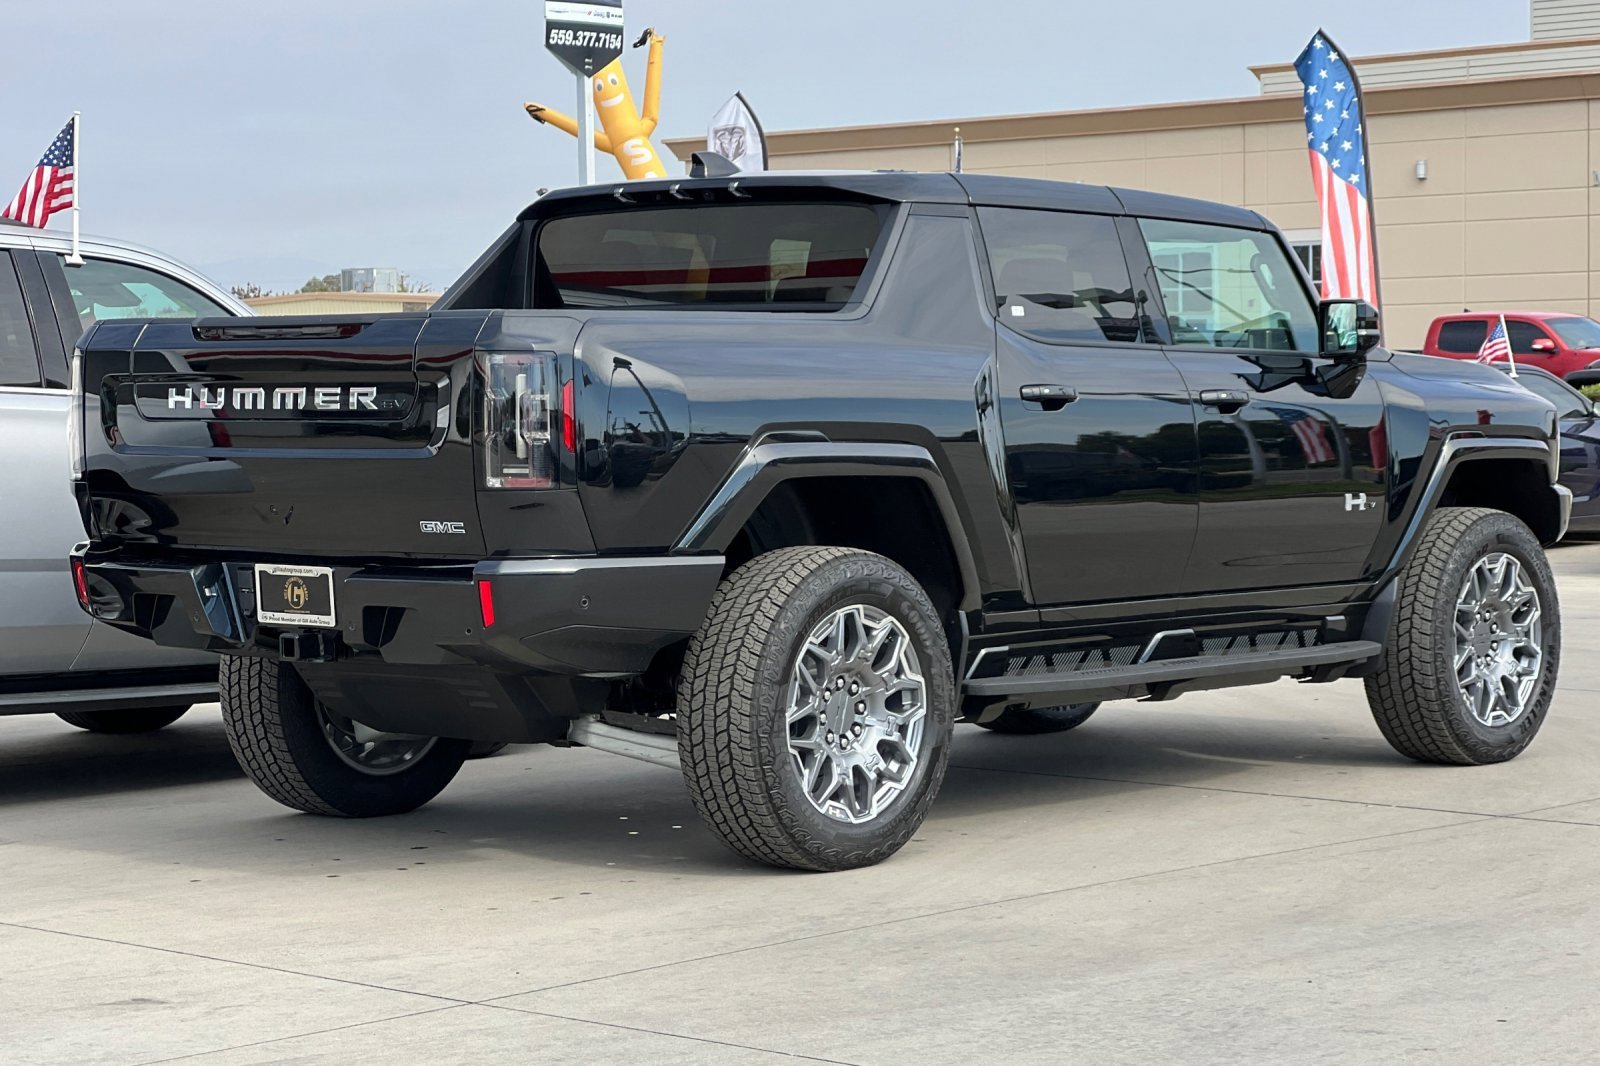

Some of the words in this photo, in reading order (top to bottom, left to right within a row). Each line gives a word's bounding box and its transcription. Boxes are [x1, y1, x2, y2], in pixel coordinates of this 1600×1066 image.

[549, 29, 622, 49] 559.377.7154
[168, 386, 378, 410] HUMMER
[419, 520, 466, 534] GMC
[1520, 644, 1556, 734] WRANGLER
